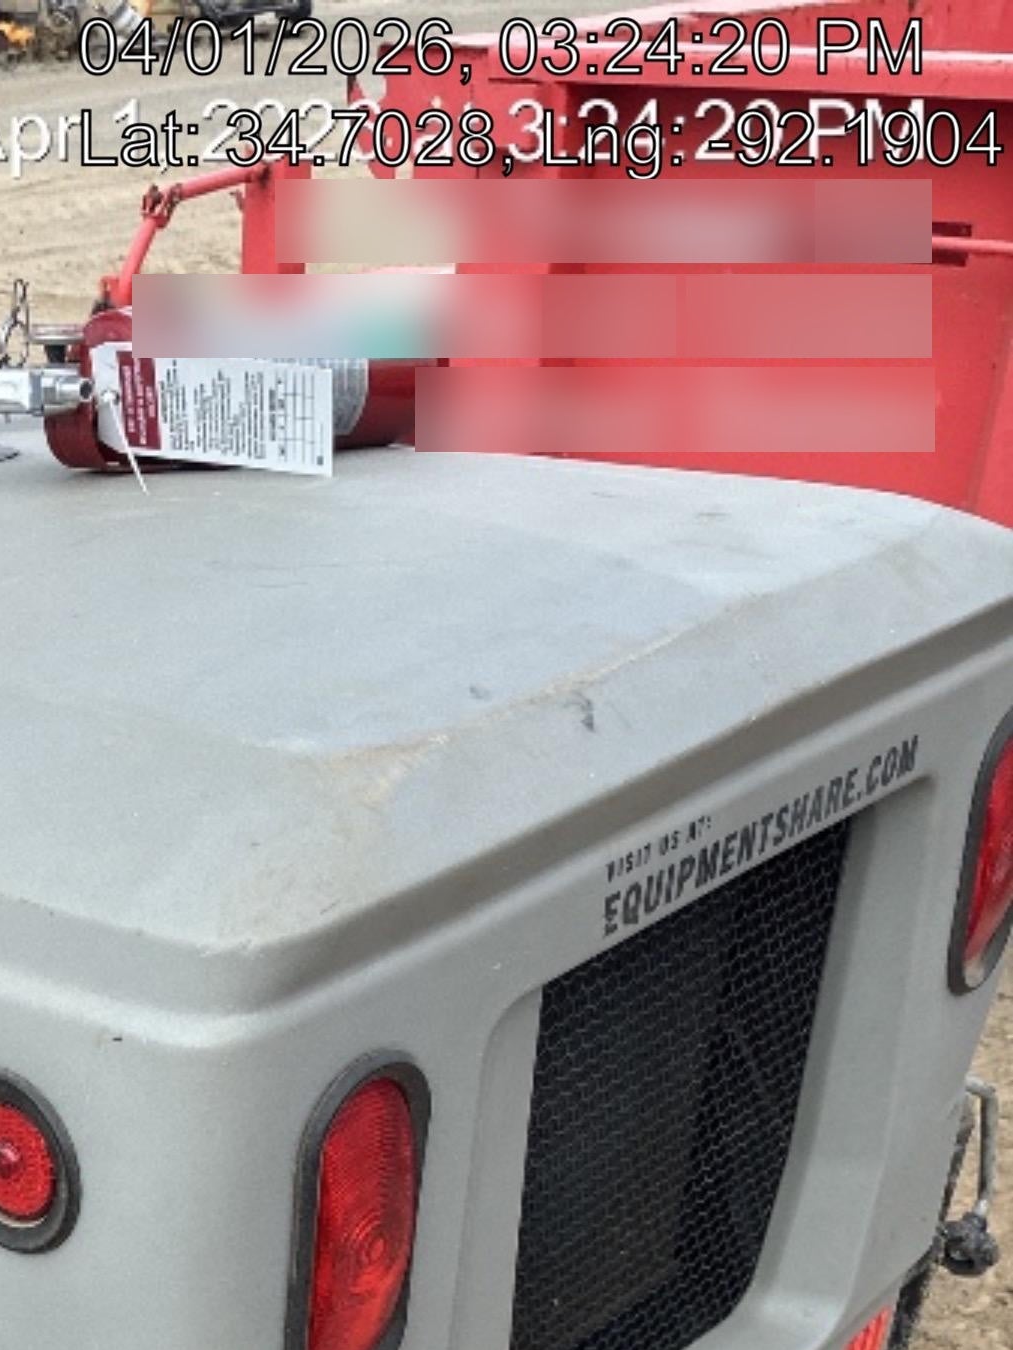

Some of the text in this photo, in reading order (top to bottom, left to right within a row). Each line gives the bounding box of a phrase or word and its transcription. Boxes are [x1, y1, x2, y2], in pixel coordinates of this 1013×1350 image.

[604, 735, 920, 937] EQUIPMENTSHARE.COM
[605, 815, 713, 884] VISIT US AT:
